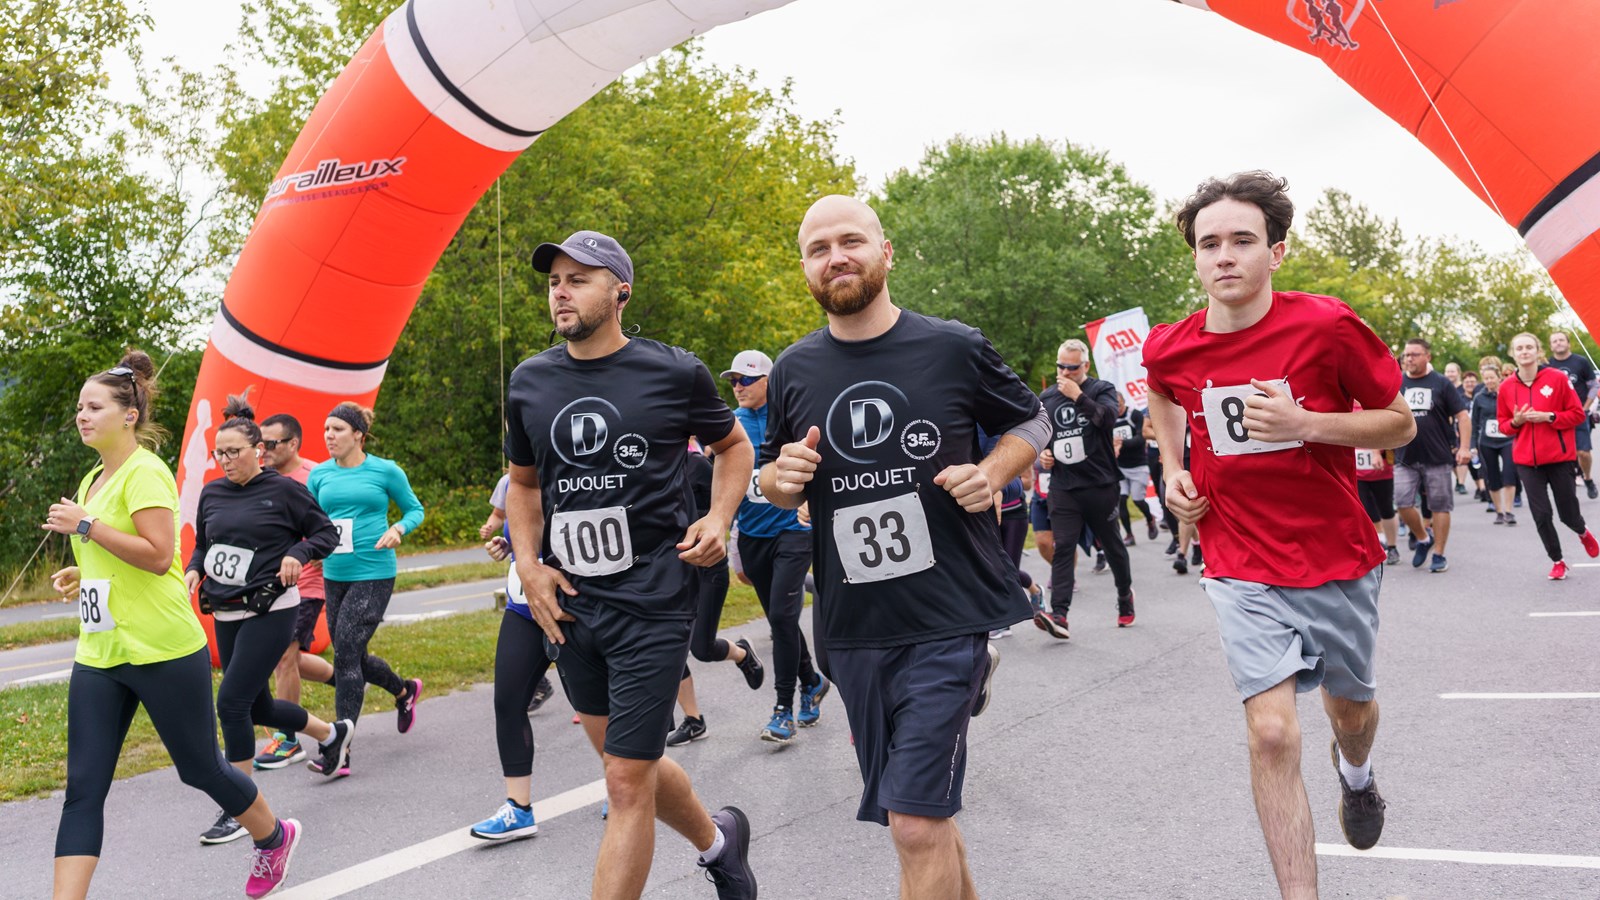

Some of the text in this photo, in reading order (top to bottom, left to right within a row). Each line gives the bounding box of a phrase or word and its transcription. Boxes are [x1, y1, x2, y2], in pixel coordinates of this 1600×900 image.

[1409, 391, 1425, 405] 43
[849, 397, 895, 449] D
[1221, 393, 1270, 443] 8
[570, 412, 609, 456] D
[906, 432, 929, 448] 35
[1056, 427, 1084, 439] DUQUET
[618, 445, 639, 458] 35
[1064, 442, 1073, 459] 9
[1356, 452, 1372, 466] 51
[558, 474, 628, 493] DUQUET
[831, 466, 916, 493] DUQUET
[559, 517, 625, 566] 100
[853, 510, 912, 568] 33
[213, 551, 241, 580] 83
[80, 587, 102, 624] 68
